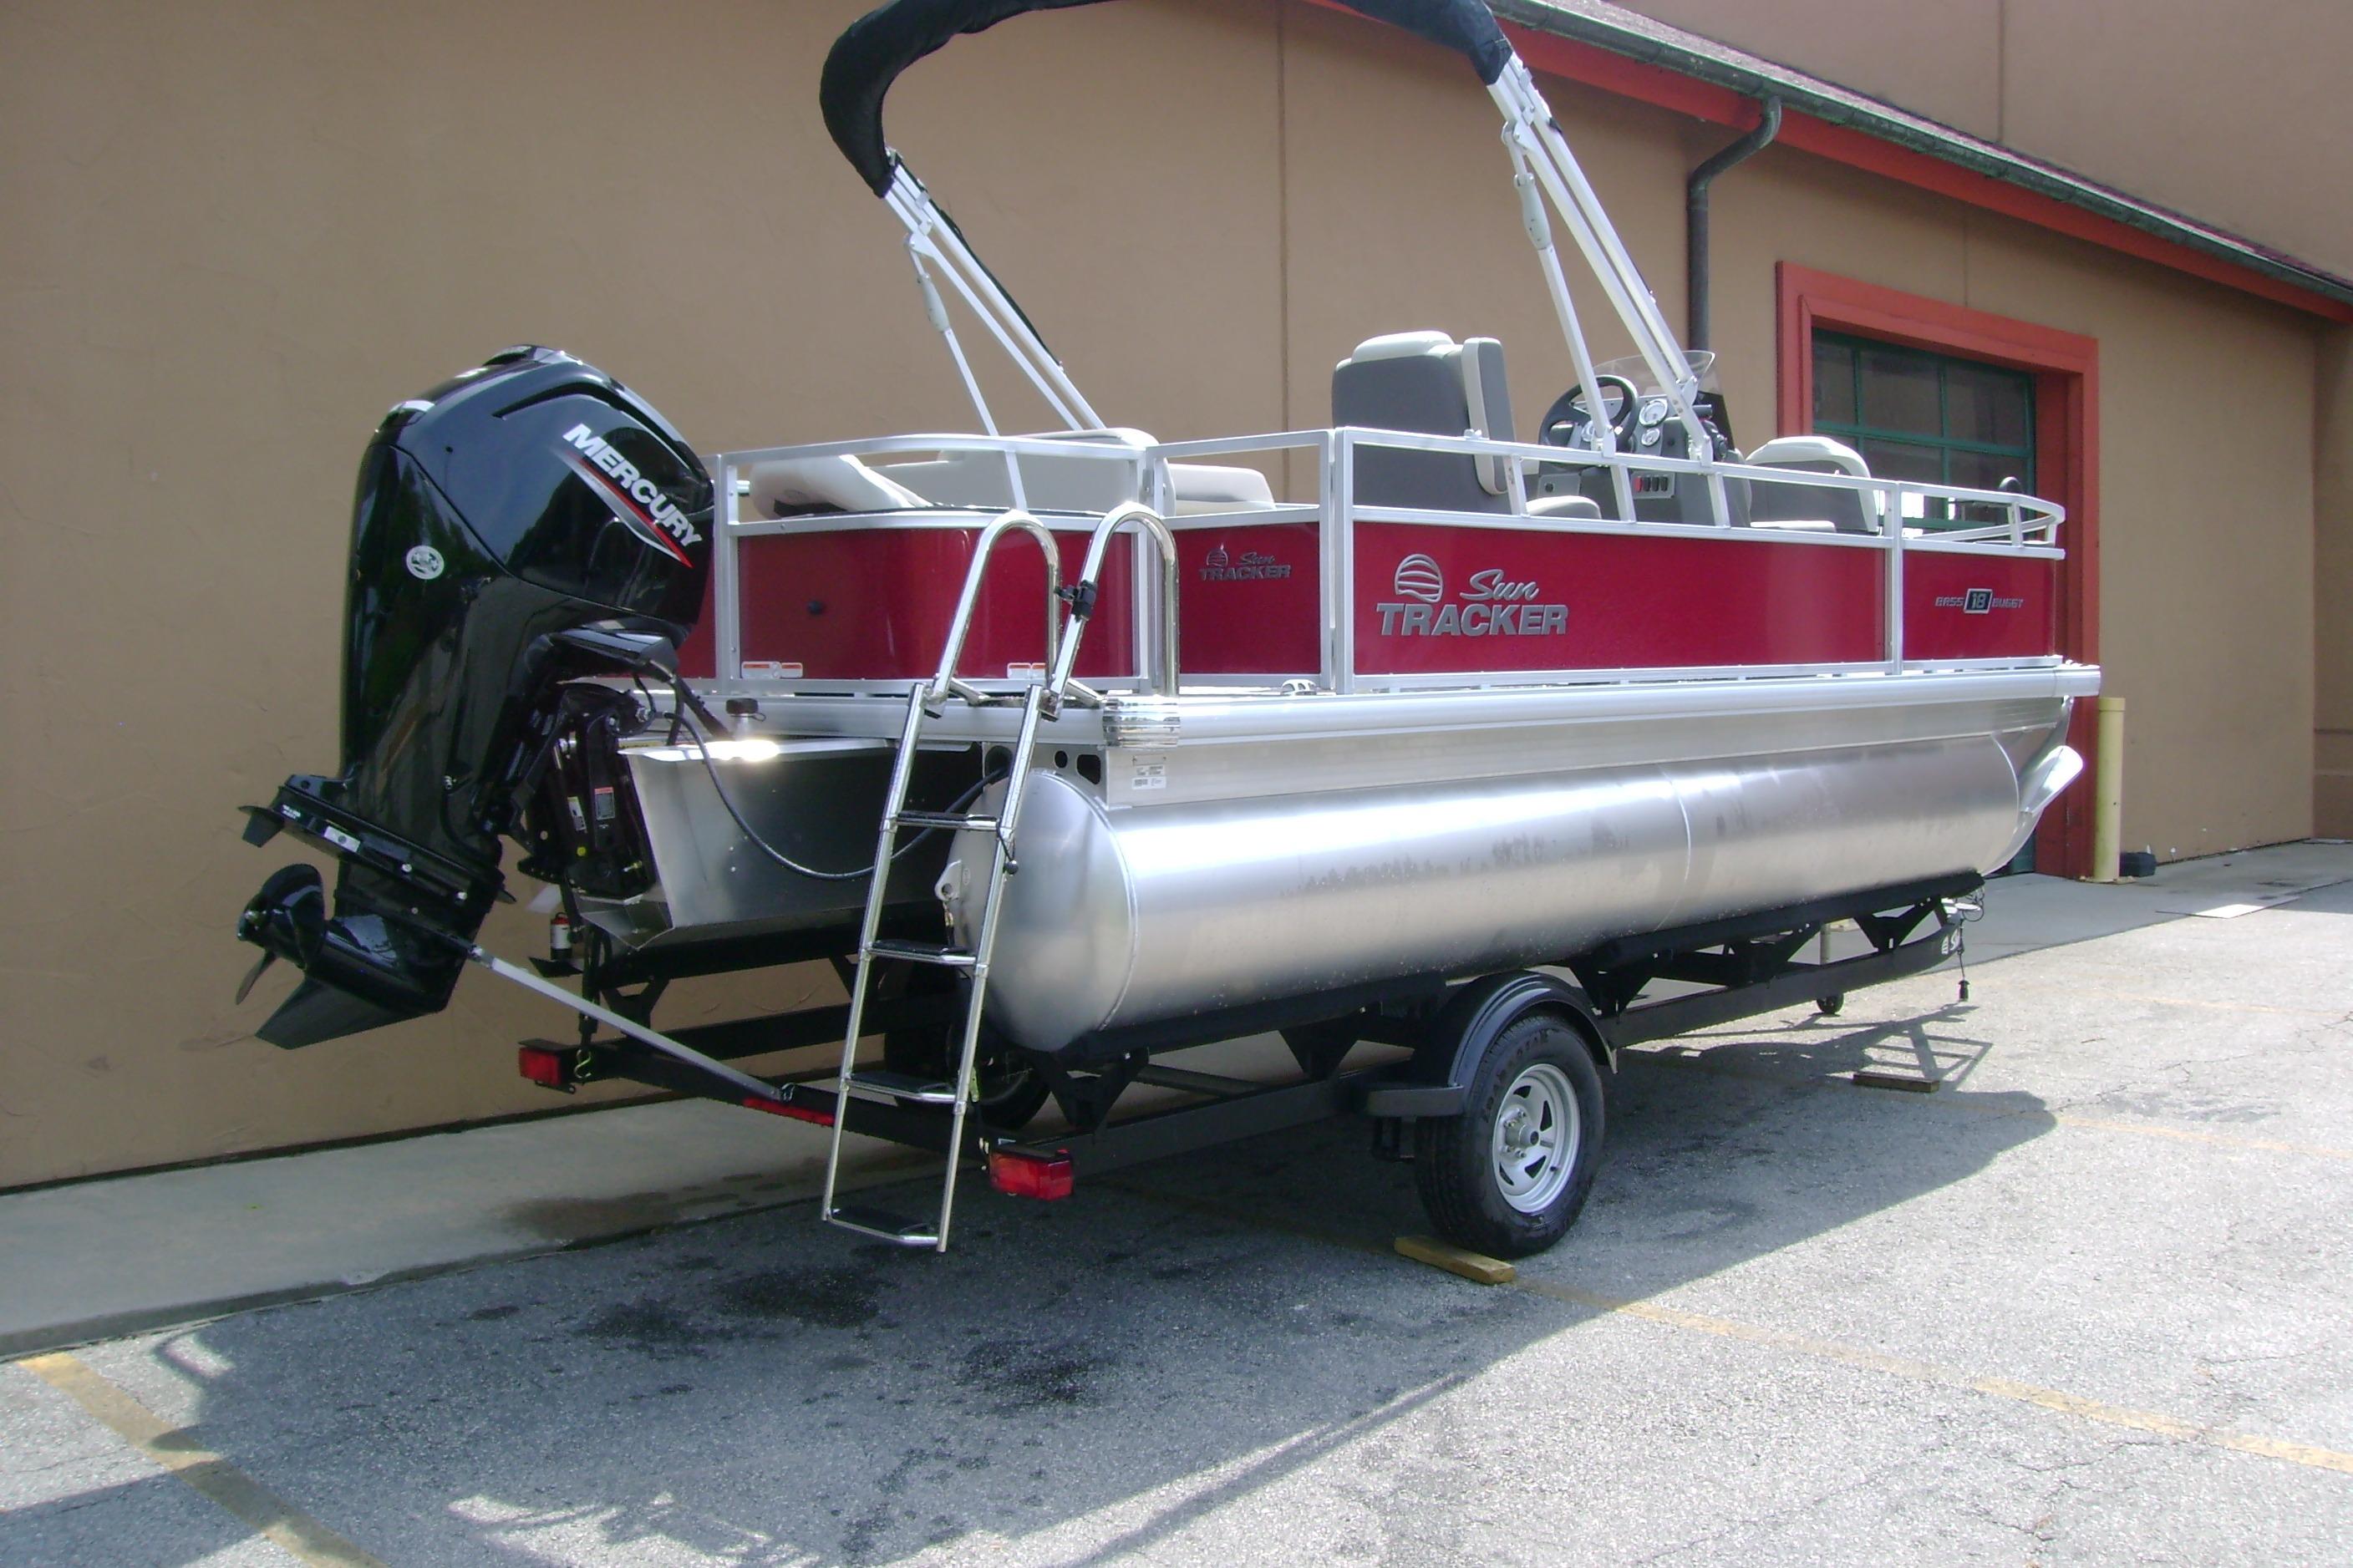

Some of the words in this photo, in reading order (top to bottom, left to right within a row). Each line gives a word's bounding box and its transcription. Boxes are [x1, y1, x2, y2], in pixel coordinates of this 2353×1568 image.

[562, 424, 703, 548] MERCURY
[1199, 565, 1291, 581] TRACKER
[1460, 569, 1539, 601] Sun
[1934, 596, 1964, 606] BASS
[1971, 592, 1987, 609] 18
[1376, 603, 1568, 637] TRACKER
